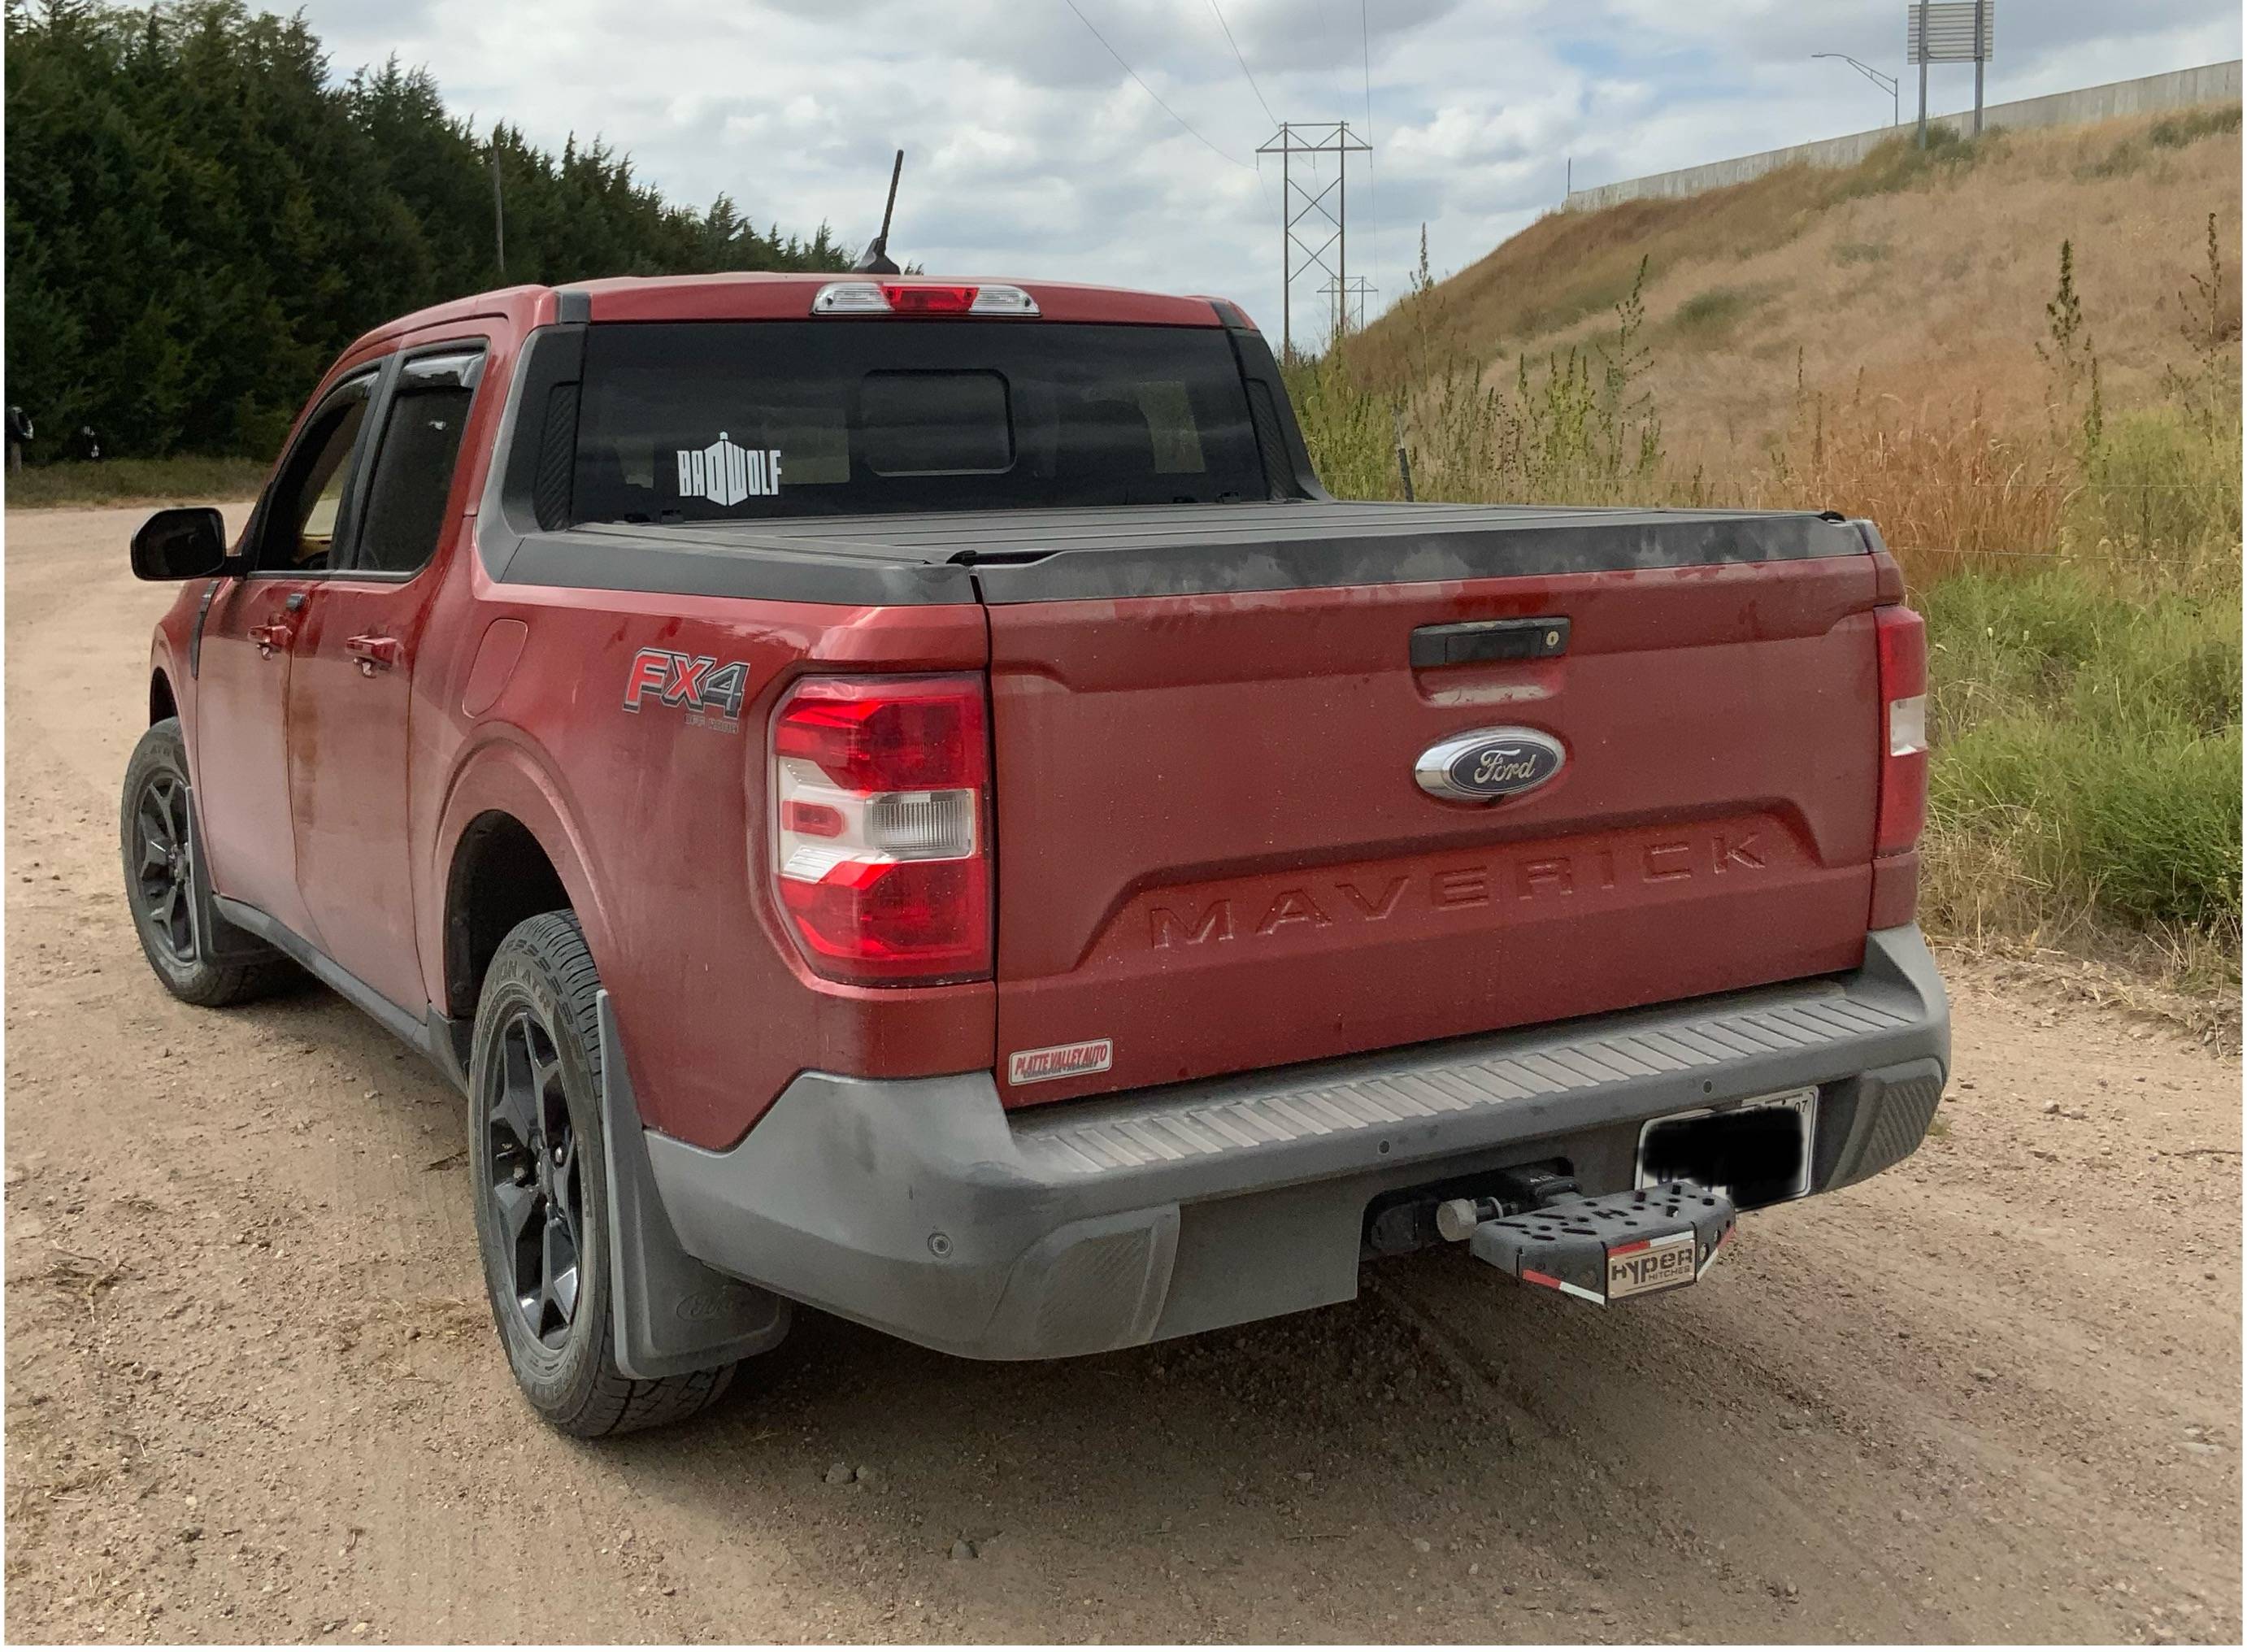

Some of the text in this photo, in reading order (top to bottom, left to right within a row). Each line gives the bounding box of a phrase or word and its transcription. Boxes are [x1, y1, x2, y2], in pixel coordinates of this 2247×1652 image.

[622, 646, 750, 719] FX4
[1473, 748, 1536, 785] Ford
[1149, 832, 1767, 951] MAVERICK
[1015, 1053, 1050, 1076] PLATTE
[1050, 1046, 1084, 1069] VALLEY
[1082, 1044, 1108, 1064] AUTO
[1793, 1099, 1809, 1114] 07
[1648, 1265, 1691, 1281] HITCHES
